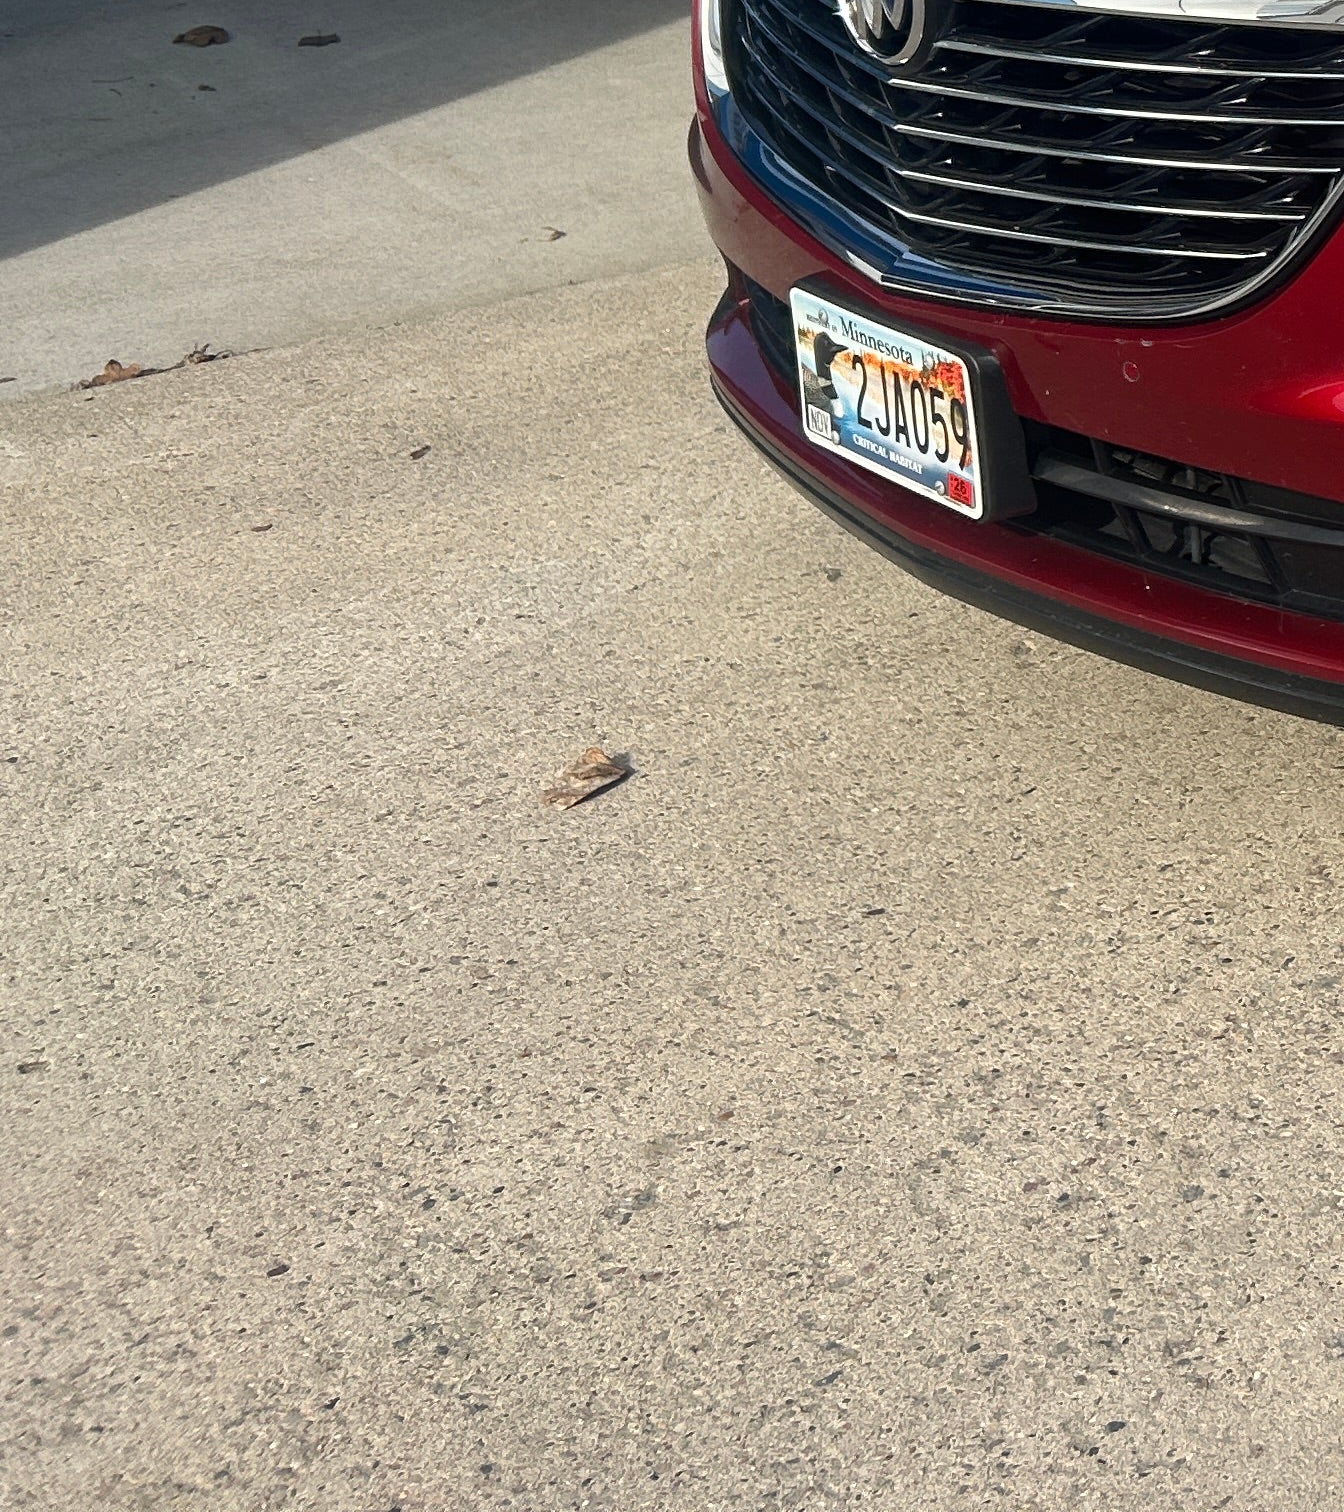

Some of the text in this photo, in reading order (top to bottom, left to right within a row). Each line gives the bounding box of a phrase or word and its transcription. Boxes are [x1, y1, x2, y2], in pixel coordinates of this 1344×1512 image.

[839, 316, 914, 366] Minnesota
[852, 354, 969, 471] 2JA059
[852, 433, 888, 459] CRITICAL
